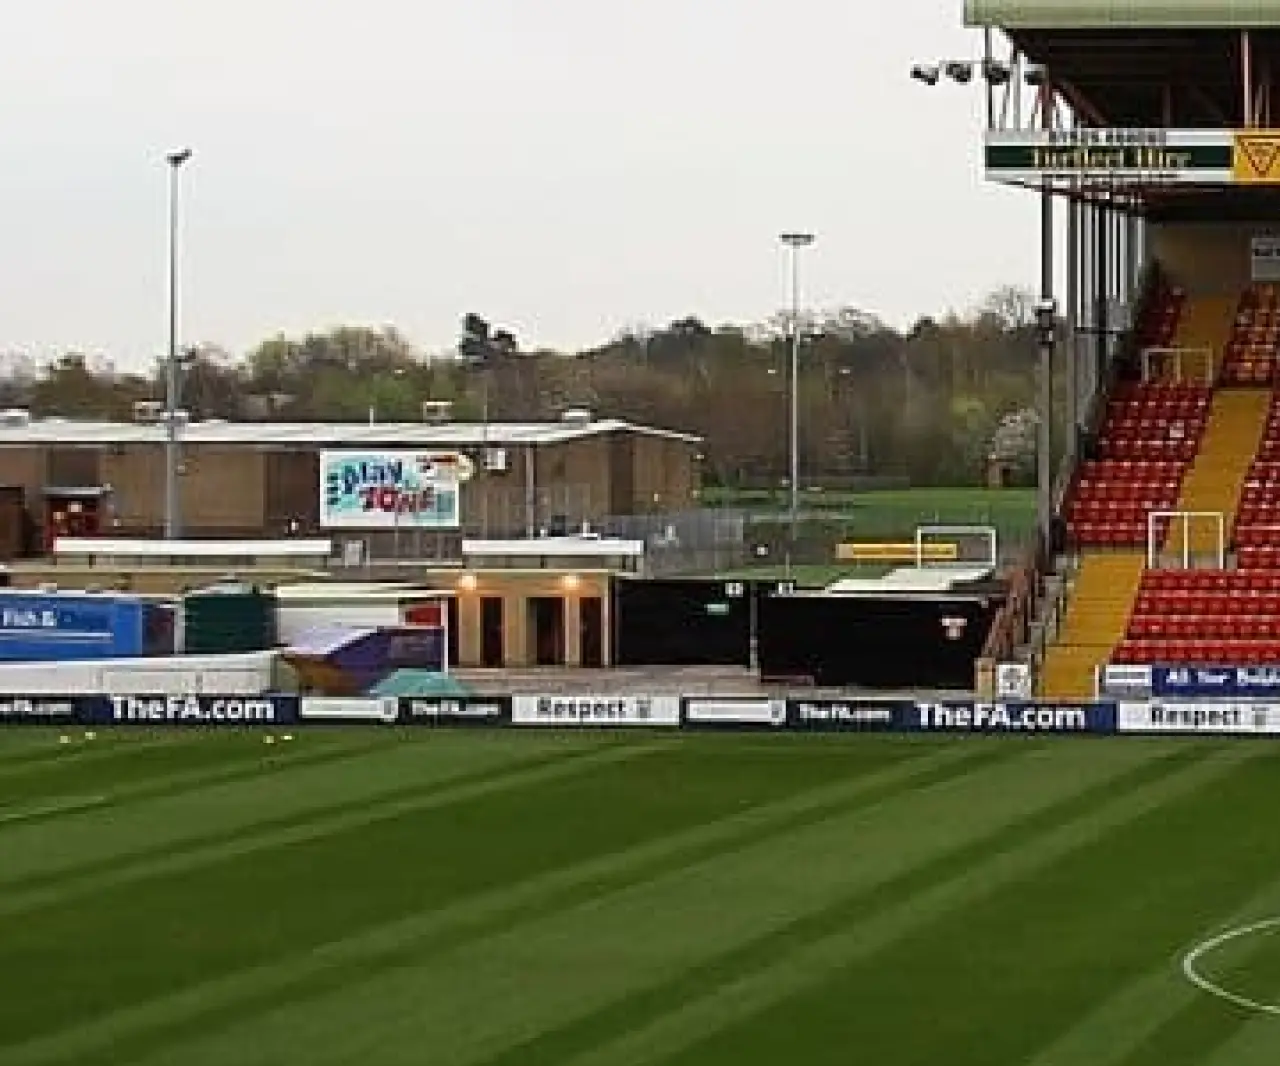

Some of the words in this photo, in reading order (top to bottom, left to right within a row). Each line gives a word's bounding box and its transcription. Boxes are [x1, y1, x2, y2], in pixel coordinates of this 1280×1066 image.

[110, 696, 275, 720] TheFA.com
[537, 699, 626, 721] Respect
[916, 702, 1086, 728] TheFA.com
[1150, 705, 1241, 733] Respect
